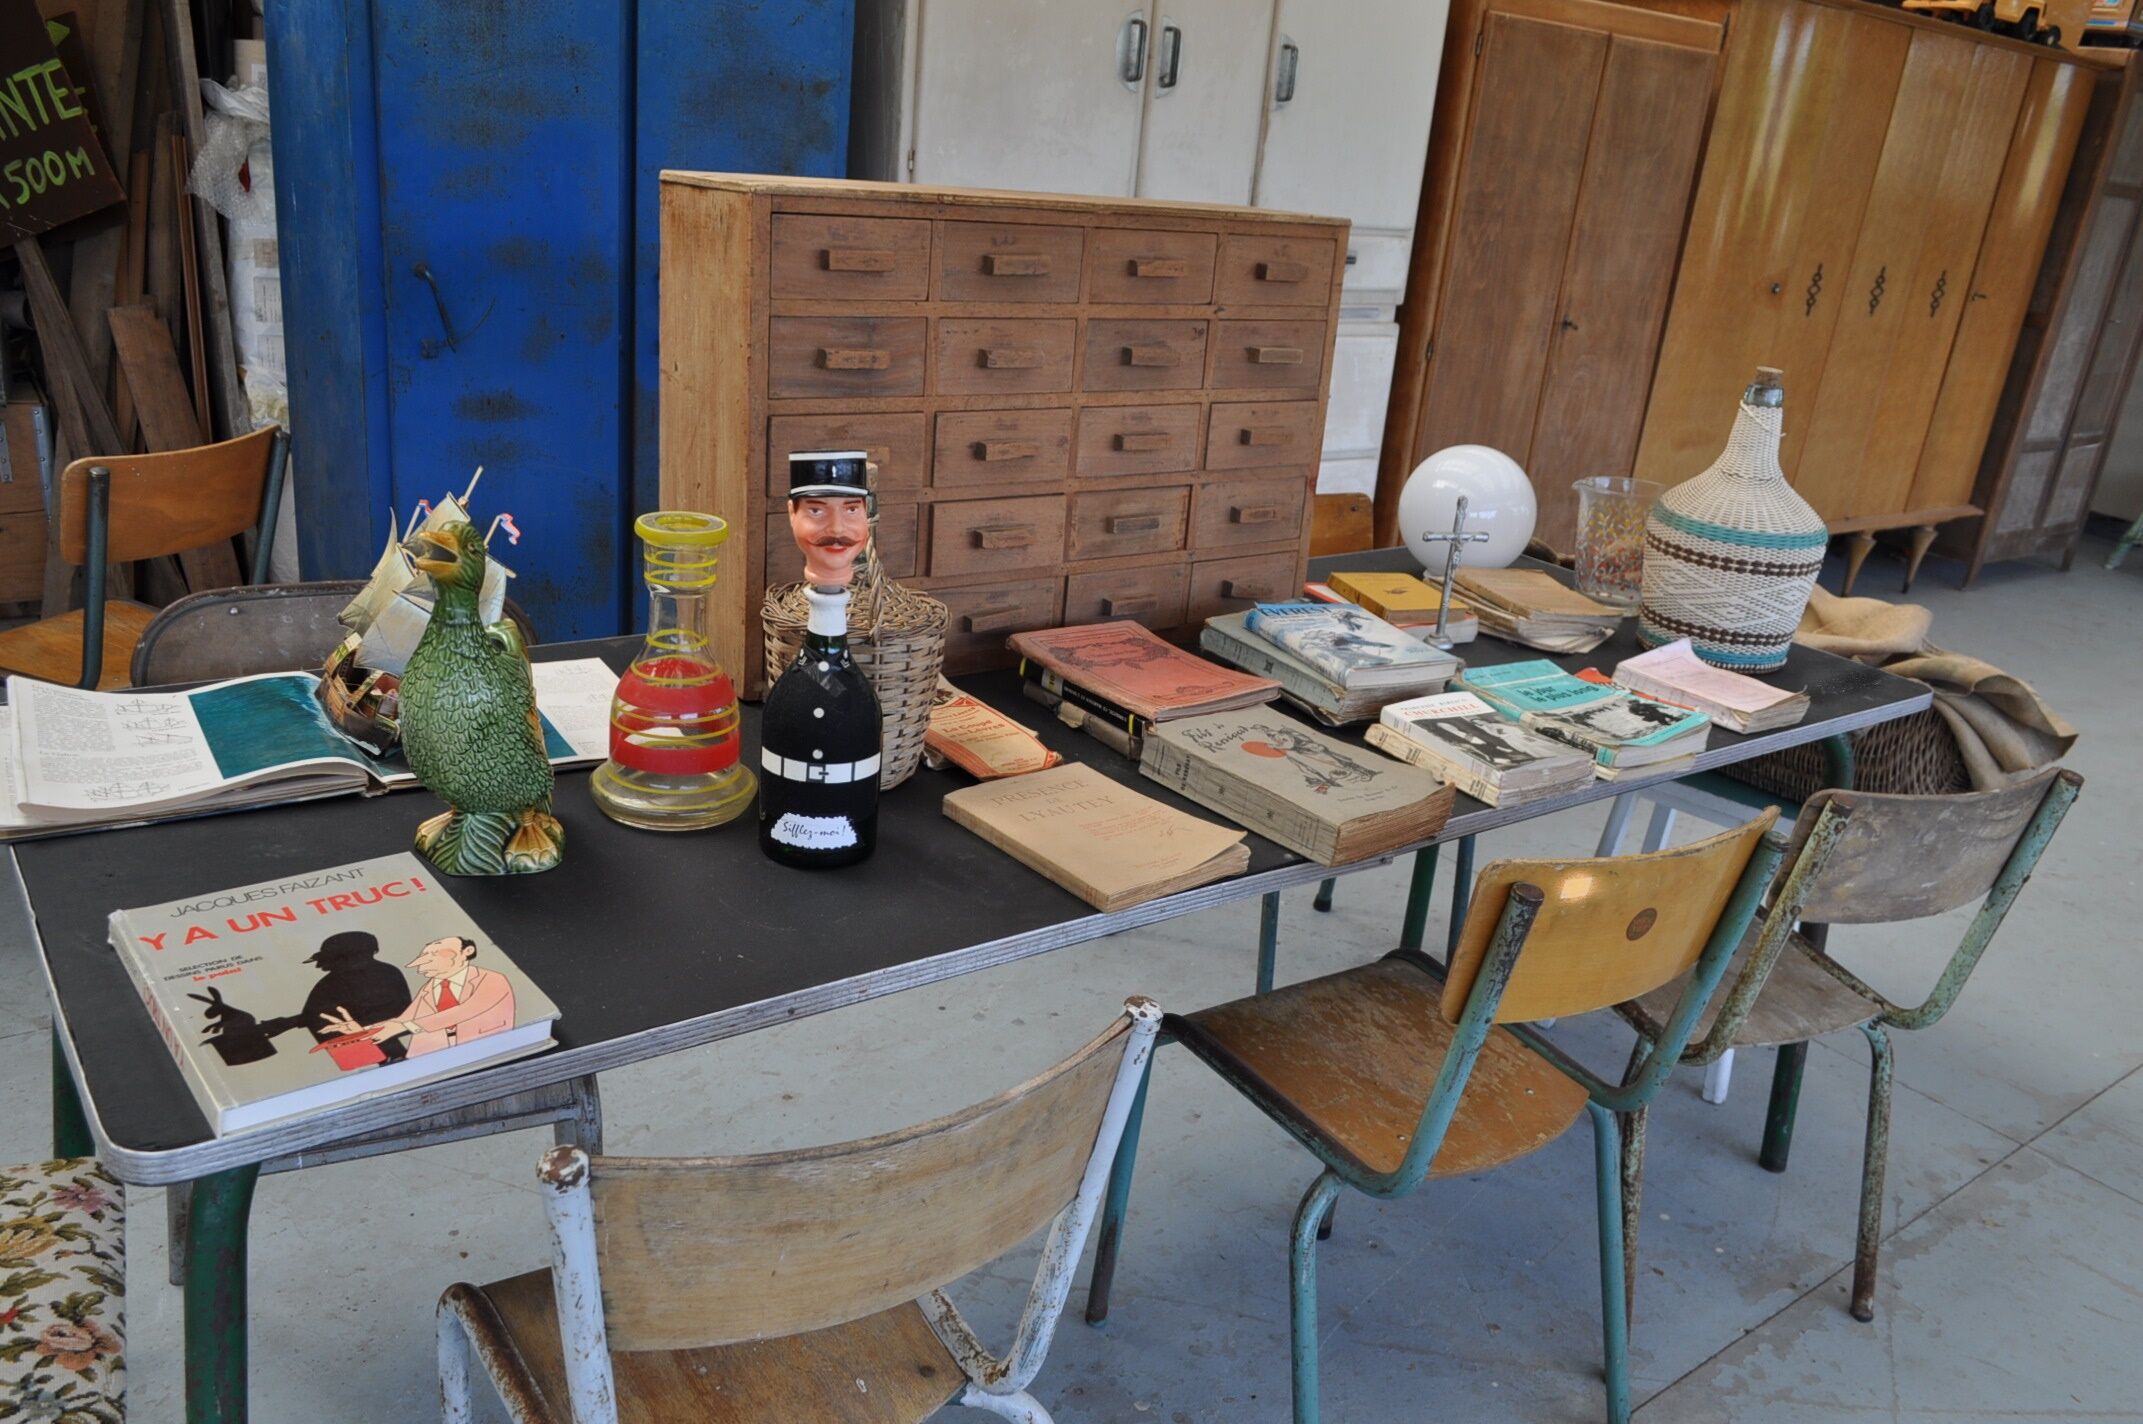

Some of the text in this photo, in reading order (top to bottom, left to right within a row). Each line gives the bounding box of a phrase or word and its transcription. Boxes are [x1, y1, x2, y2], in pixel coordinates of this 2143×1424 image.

[0, 58, 83, 140] NTE
[1259, 607, 1333, 617] EVEREST
[1404, 703, 1479, 717] CHURCHILL
[170, 867, 365, 918] JACQUES FAIZANT
[139, 931, 167, 951] Y
[184, 926, 219, 945] A
[226, 905, 298, 933] UN
